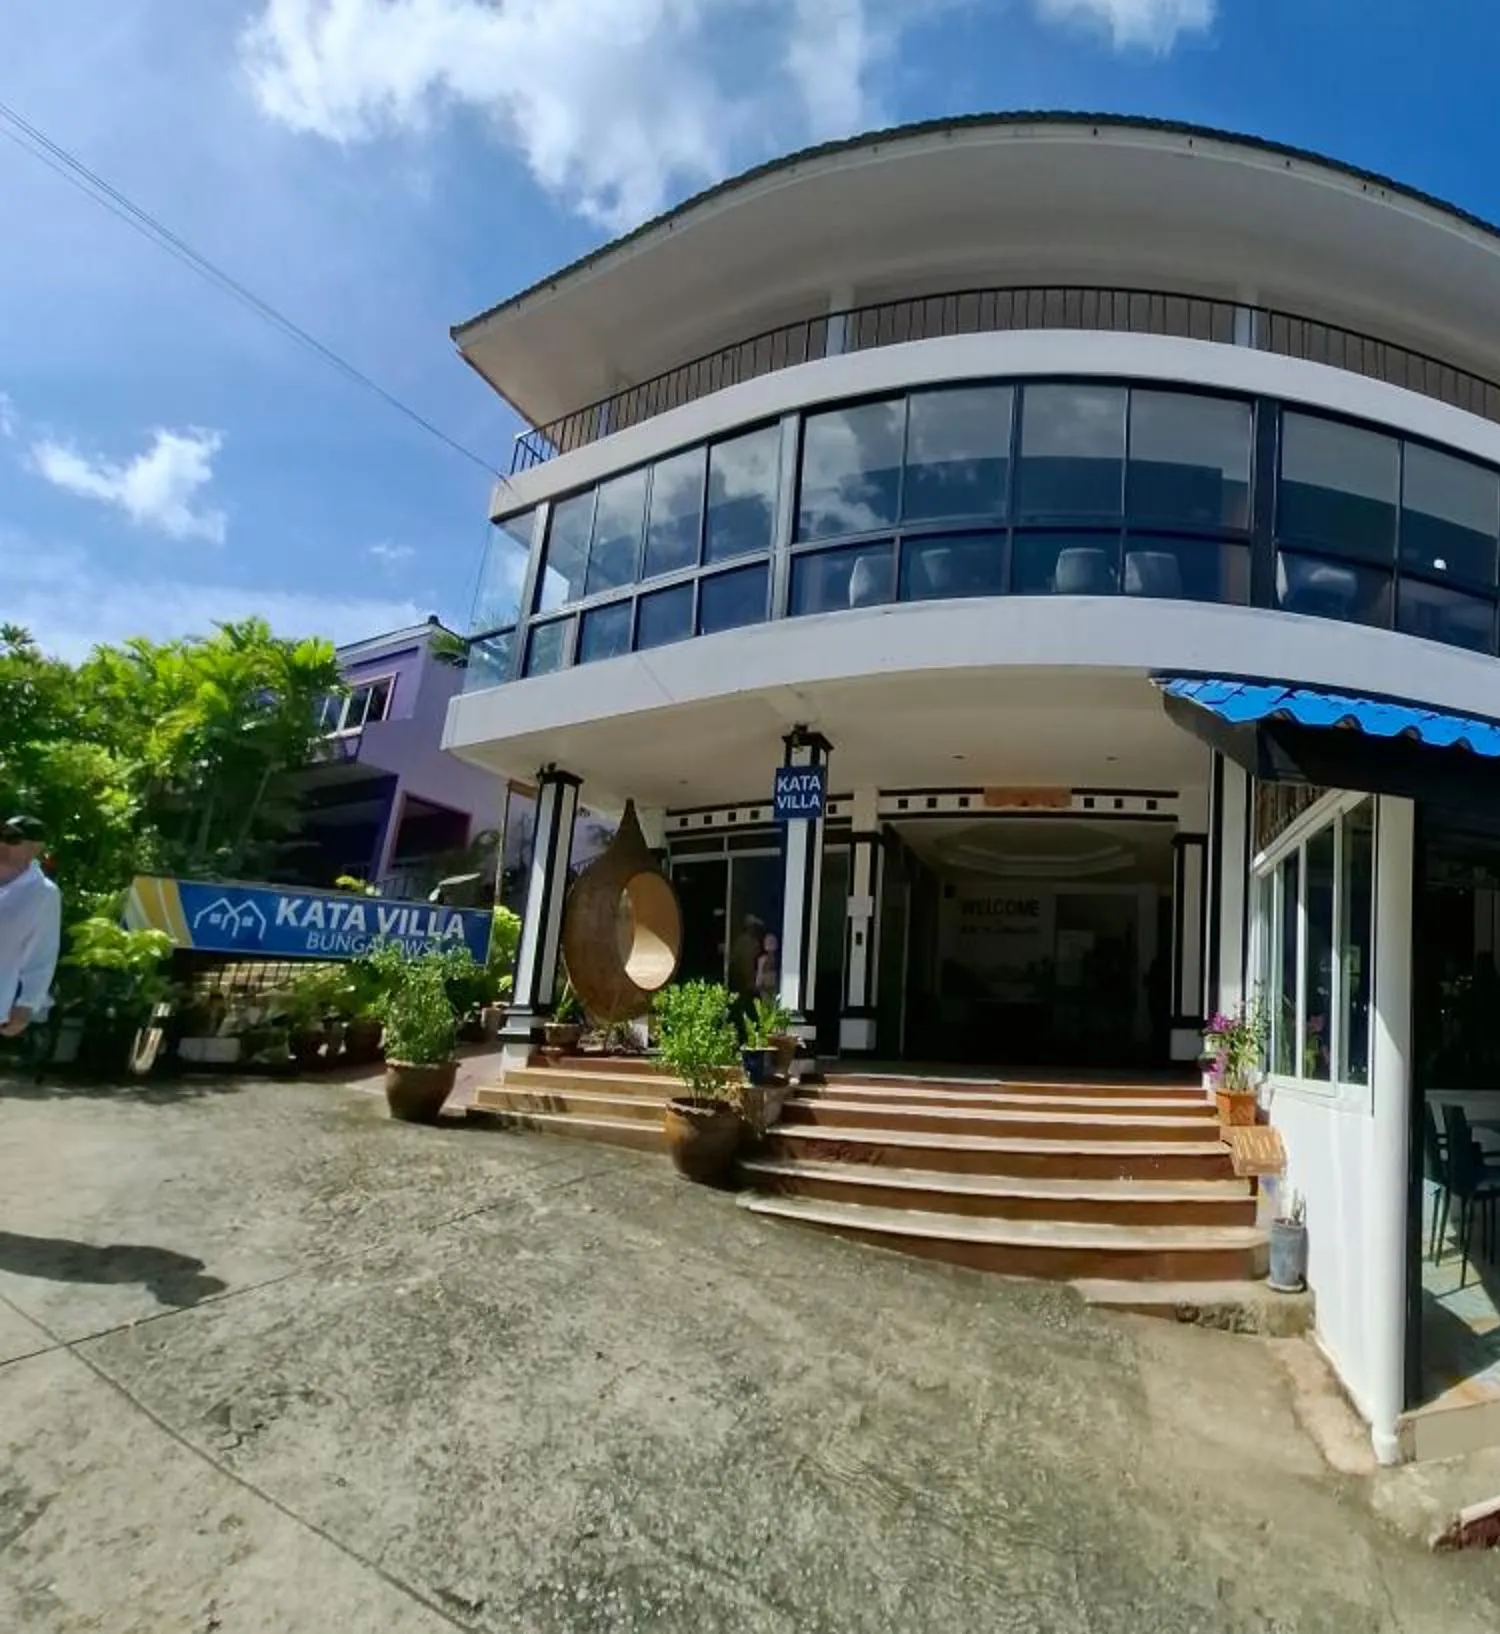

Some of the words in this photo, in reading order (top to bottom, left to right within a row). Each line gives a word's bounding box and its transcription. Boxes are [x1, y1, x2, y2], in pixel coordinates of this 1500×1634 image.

[778, 775, 821, 791] KATA
[778, 794, 820, 809] VILLA
[276, 898, 366, 930] KATA
[377, 907, 465, 940] VILLA
